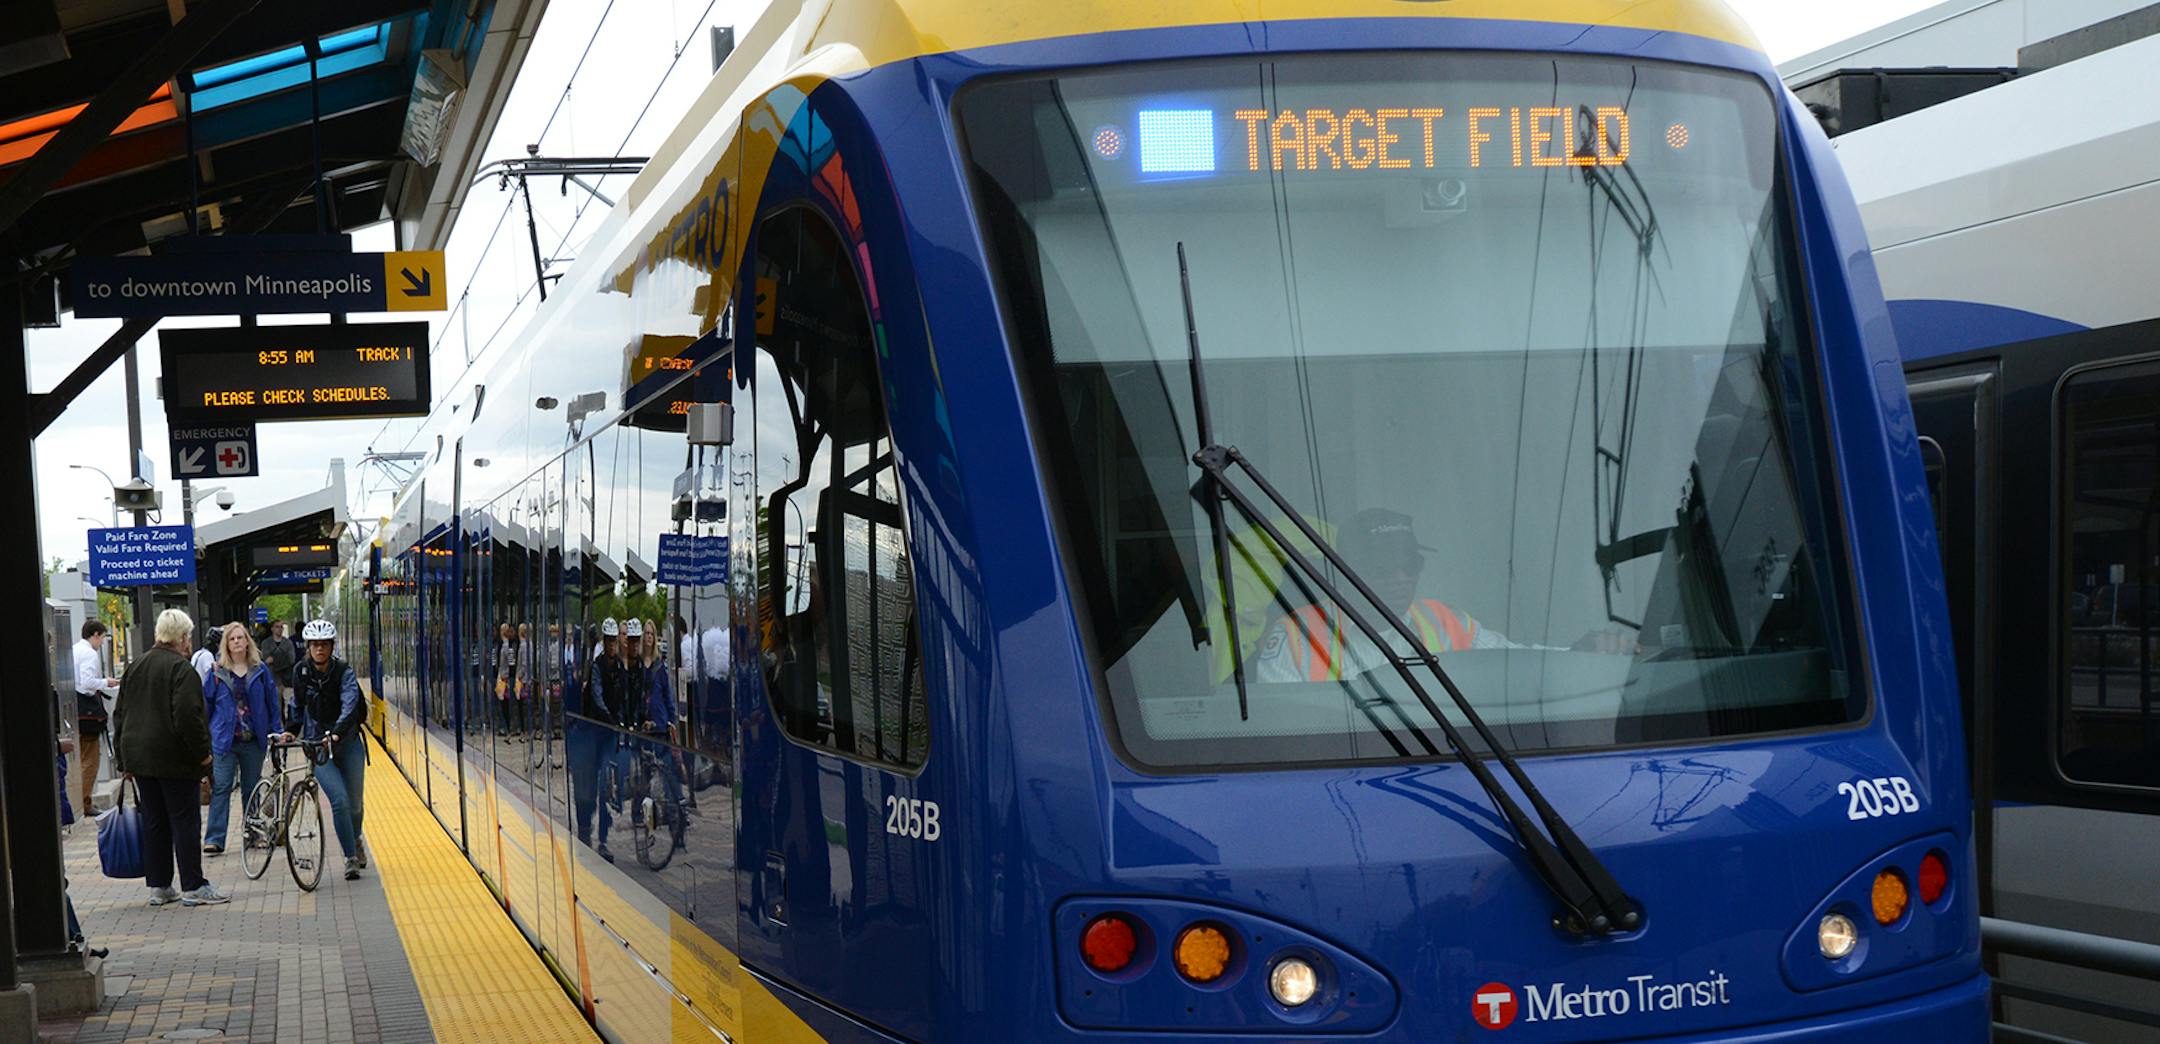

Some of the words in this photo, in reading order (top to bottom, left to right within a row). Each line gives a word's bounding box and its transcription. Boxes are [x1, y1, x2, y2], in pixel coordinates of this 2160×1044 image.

[1235, 108, 1443, 171] TARGET
[1468, 106, 1631, 168] FIELD
[88, 281, 112, 298] to
[121, 276, 237, 297] downtown
[245, 273, 372, 299] Minneapolis
[258, 351, 288, 365] 8:55
[295, 350, 315, 364] AM
[356, 347, 400, 362] TRACK
[204, 391, 255, 406] PLEASE
[263, 390, 305, 404] CHECK
[312, 386, 391, 403] SCHEDULES.
[174, 427, 250, 440] EMERGENCY
[105, 532, 126, 541] Paid
[128, 531, 149, 541] Fare
[151, 530, 177, 540] Zone
[95, 544, 119, 554] Valid
[121, 543, 142, 553] Fare
[145, 541, 188, 553] Required
[100, 559, 140, 569] Proceed
[143, 559, 154, 568] to
[157, 557, 184, 567] ticket
[108, 571, 148, 580] machine
[150, 569, 179, 579] ahead
[1838, 776, 1920, 820] 205B
[886, 795, 941, 841] 205B
